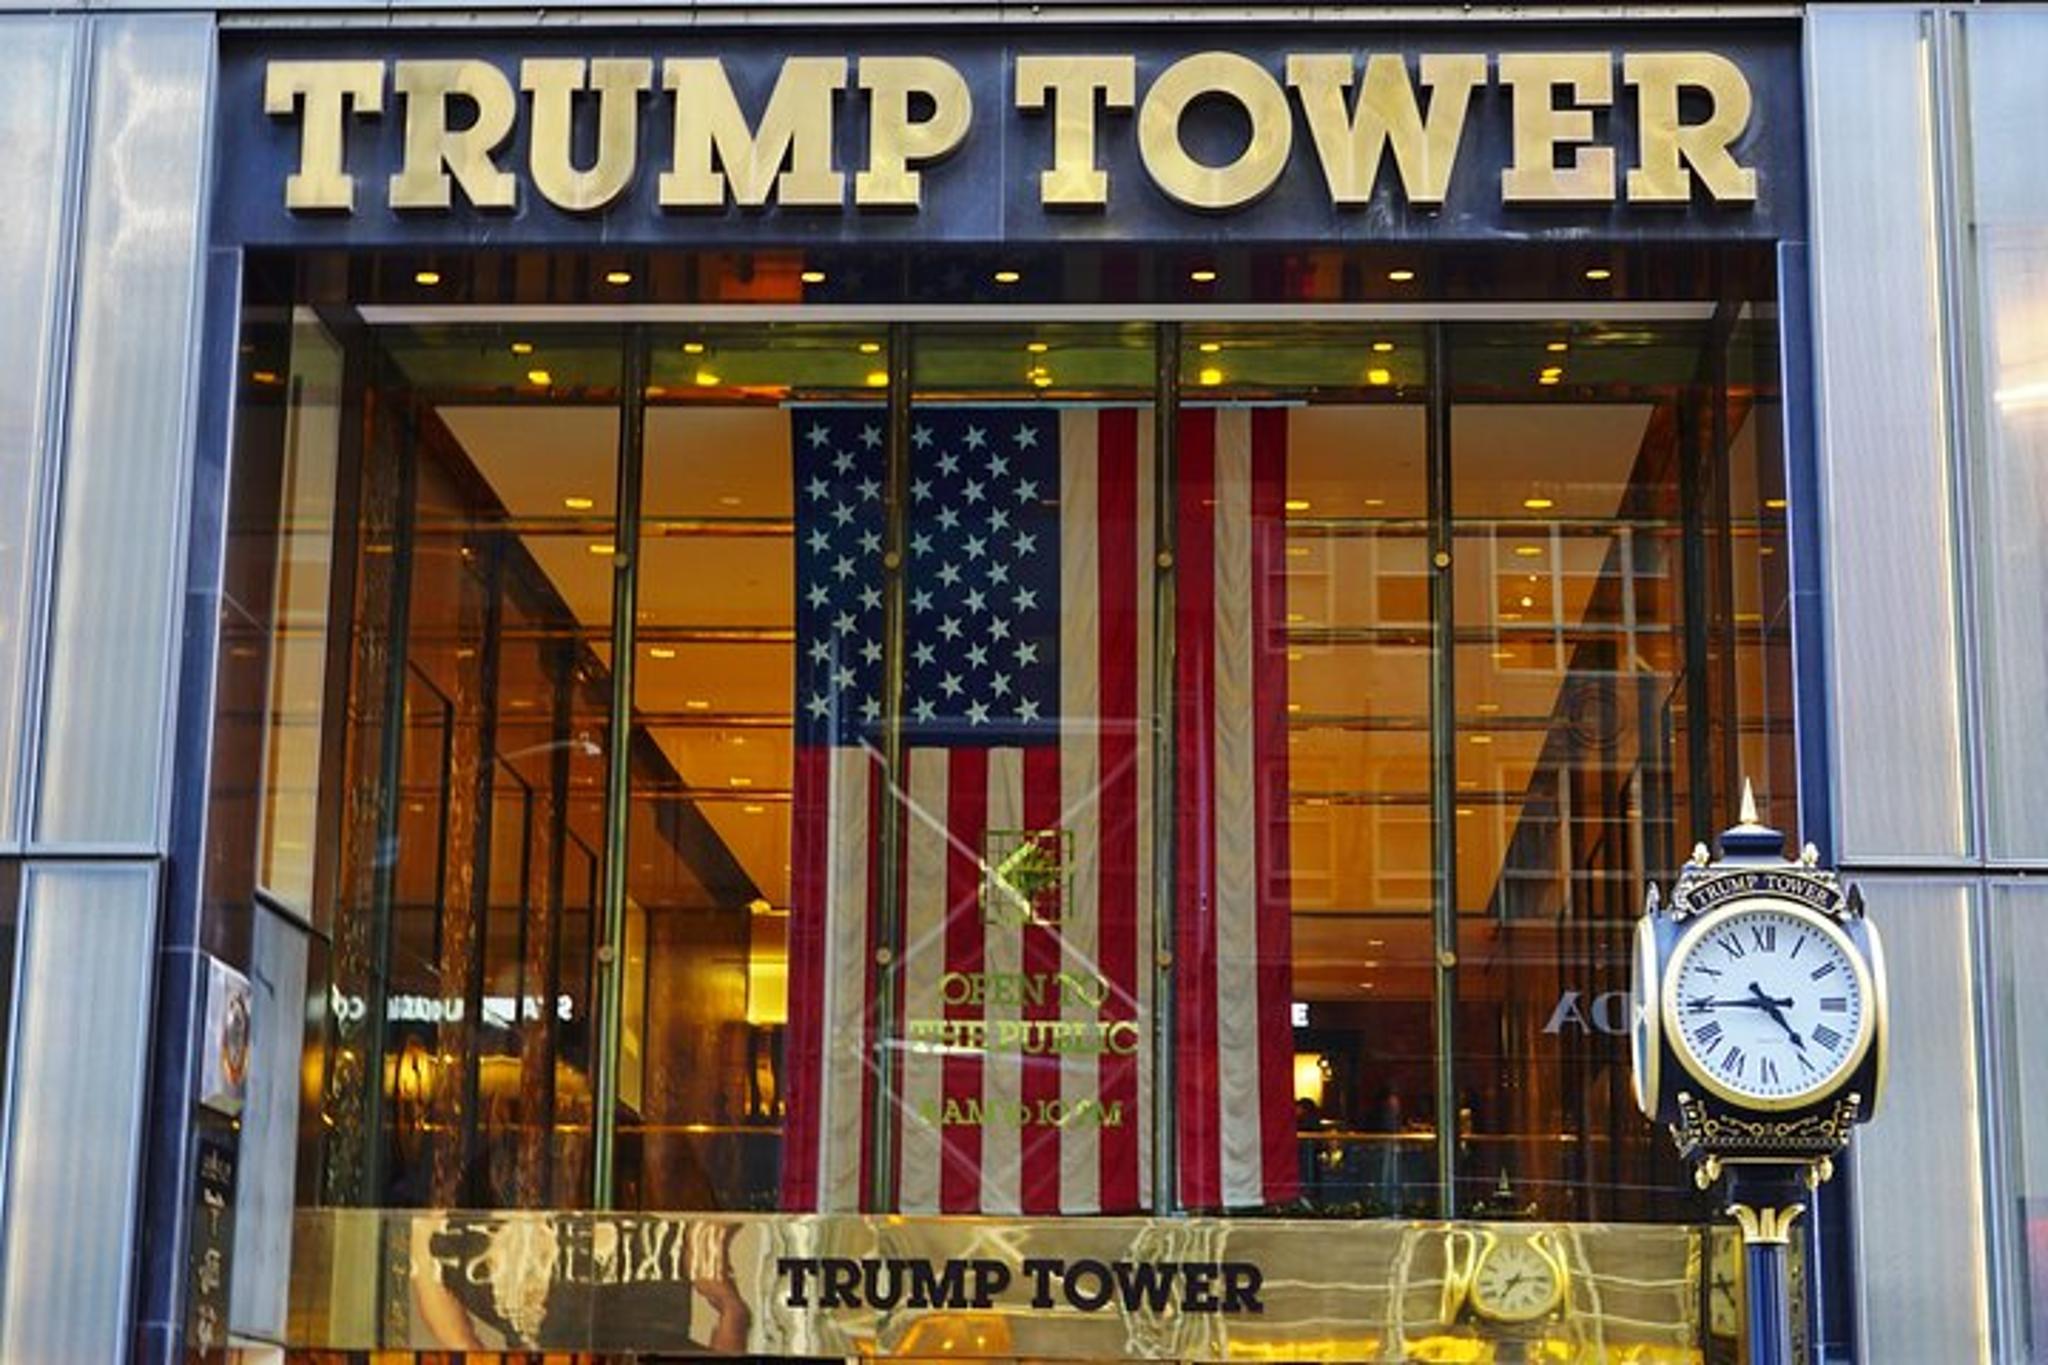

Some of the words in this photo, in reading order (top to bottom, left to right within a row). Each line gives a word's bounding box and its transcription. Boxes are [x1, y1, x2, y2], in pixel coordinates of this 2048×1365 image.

[263, 55, 973, 212] TRUMP
[1014, 50, 1759, 210] TOWER
[1694, 874, 1760, 905] TRUMP
[1764, 874, 1830, 906] TOWER
[1750, 925, 1776, 953] XII
[938, 971, 1047, 1006] OPEN
[1819, 996, 1848, 1013] III
[910, 1019, 988, 1050] THE
[997, 1019, 1140, 1054] PUBLIC
[776, 1257, 1013, 1312] TRUMP
[1023, 1259, 1265, 1314] TOWER
